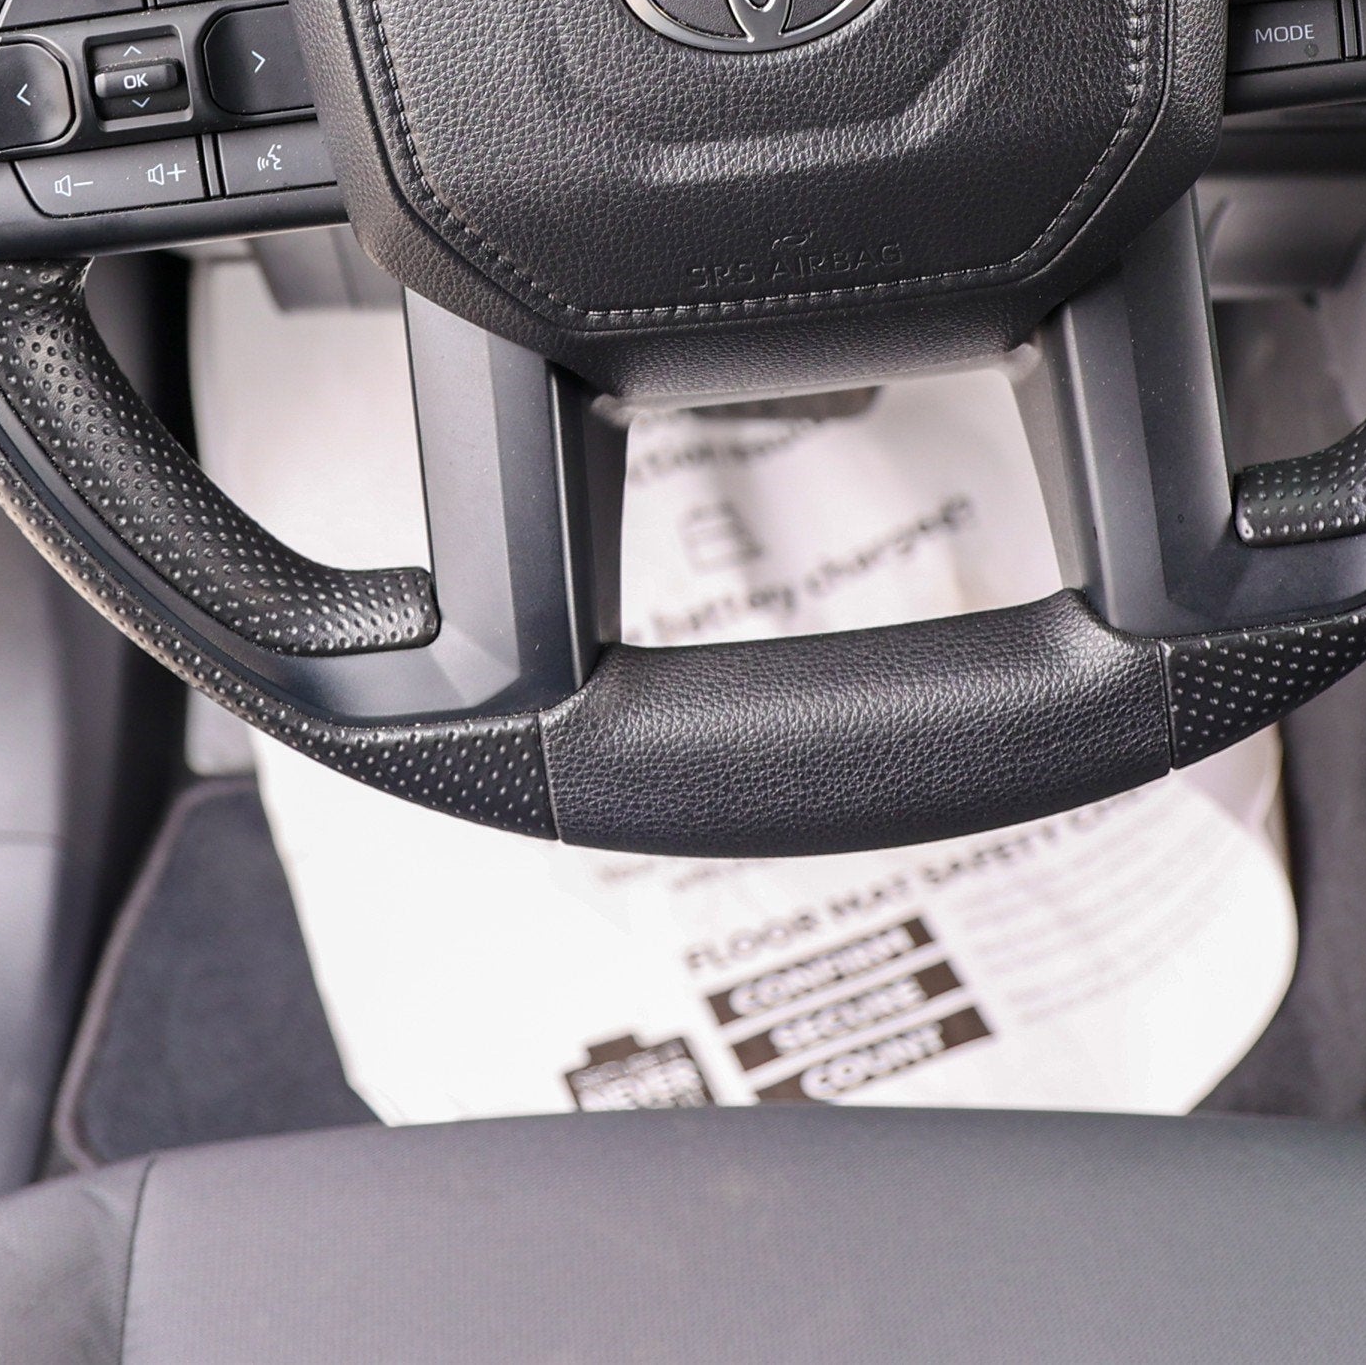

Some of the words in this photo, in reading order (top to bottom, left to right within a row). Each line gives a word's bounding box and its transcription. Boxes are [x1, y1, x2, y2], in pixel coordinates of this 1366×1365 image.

[1254, 23, 1315, 44] MODE
[123, 72, 149, 89] OK
[691, 263, 756, 290] SRS
[771, 242, 904, 281] AIRBAG
[685, 910, 820, 970] FLOOR
